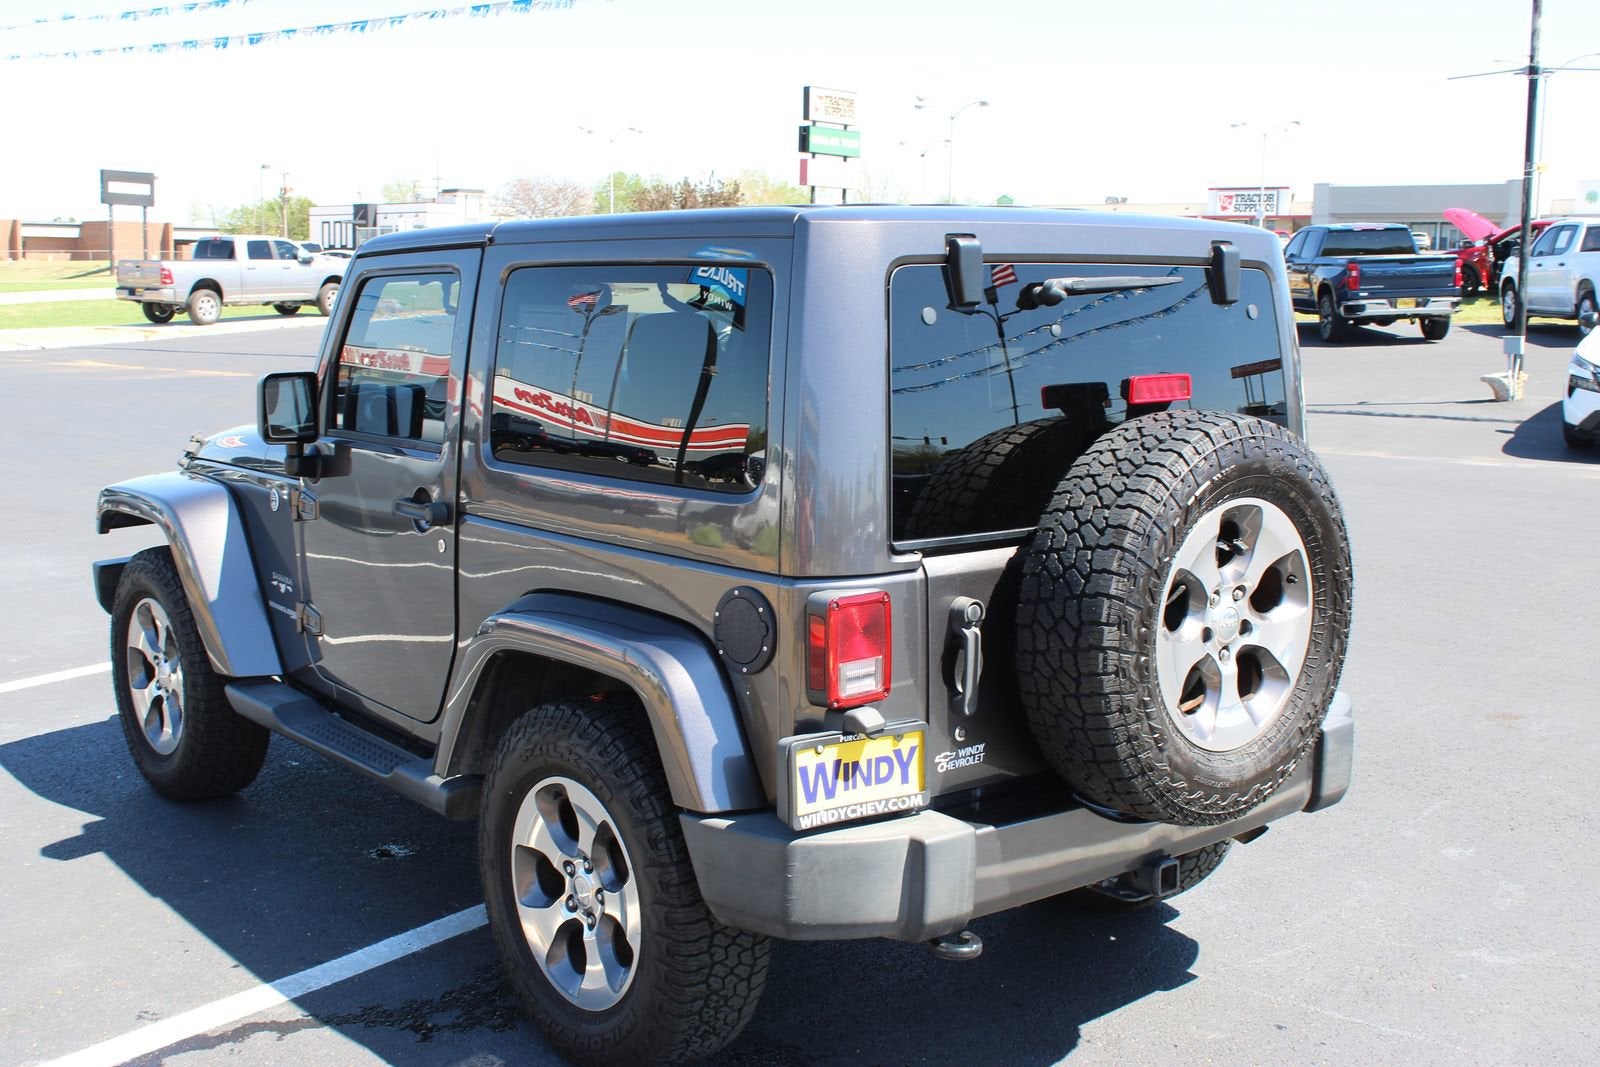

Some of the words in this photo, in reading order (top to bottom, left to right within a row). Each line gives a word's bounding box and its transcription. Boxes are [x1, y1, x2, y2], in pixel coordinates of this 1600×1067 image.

[937, 752, 986, 773] CHEVROLET
[958, 743, 986, 758] WINDY
[799, 745, 918, 805] WINDY
[799, 793, 924, 829] WINDYCHEV.COM
